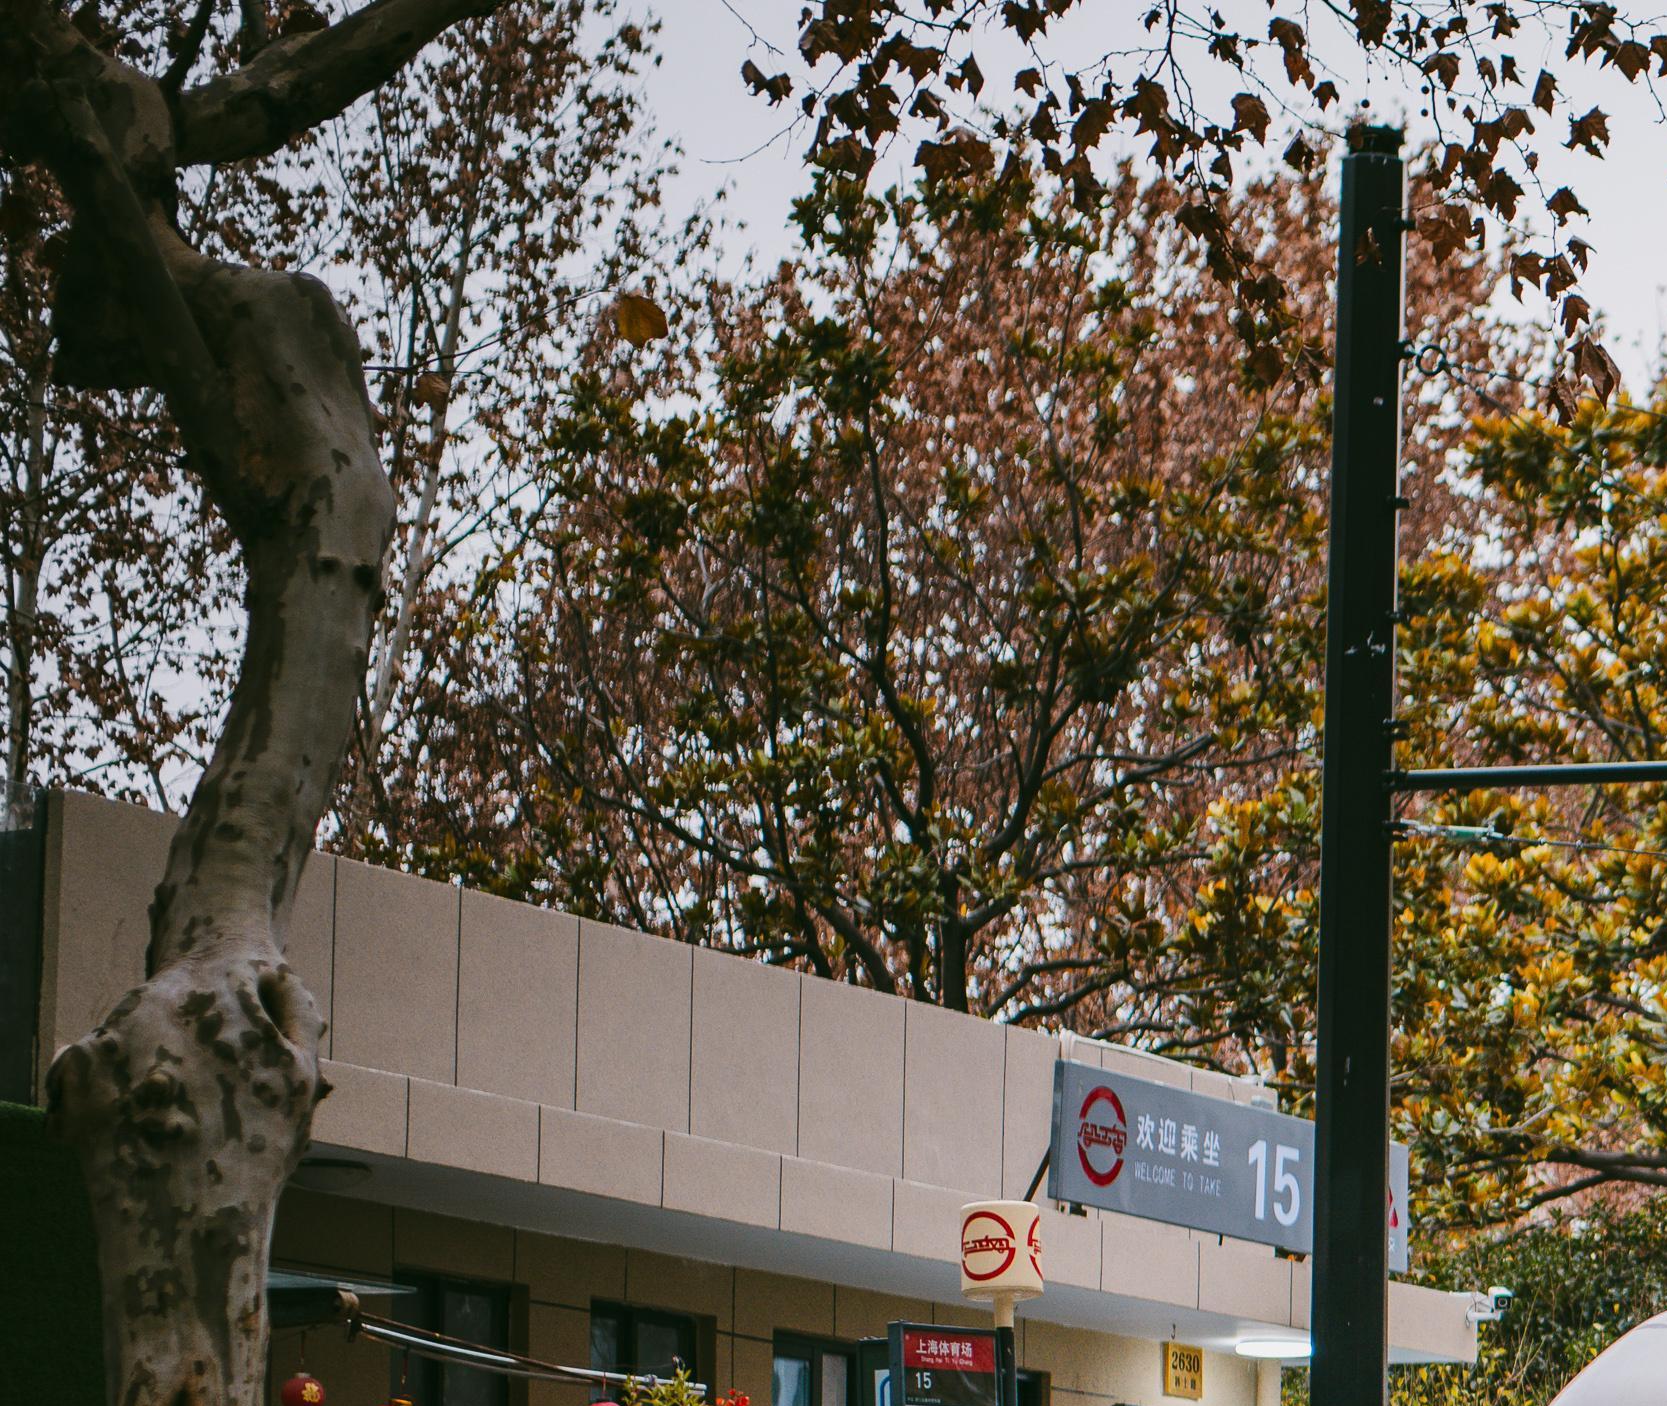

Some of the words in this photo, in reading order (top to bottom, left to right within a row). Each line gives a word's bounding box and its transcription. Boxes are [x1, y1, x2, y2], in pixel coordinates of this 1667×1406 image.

[1136, 1113, 1221, 1168] 欢迎乘坐
[1134, 1161, 1176, 1189] WELCOME
[1182, 1173, 1194, 1191] TO
[1200, 1175, 1222, 1198] TAKE
[1248, 1139, 1300, 1227] 15
[916, 1338, 973, 1359] 上海体育场
[1171, 1350, 1200, 1374] 2630
[916, 1371, 932, 1389] 15
